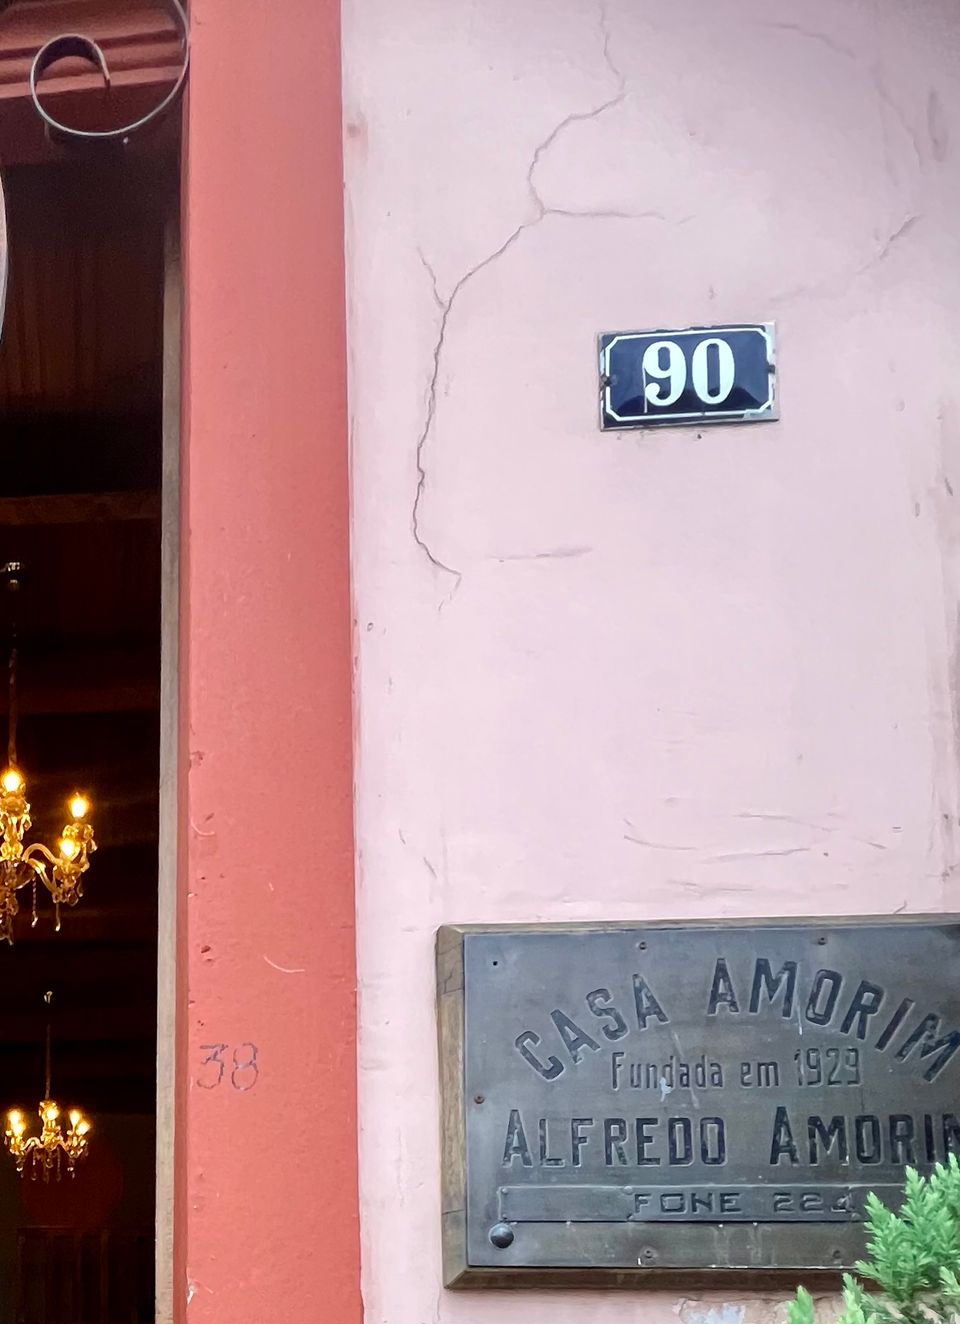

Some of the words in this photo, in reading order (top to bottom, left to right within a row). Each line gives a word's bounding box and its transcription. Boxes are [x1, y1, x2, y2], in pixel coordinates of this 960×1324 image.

[642, 338, 736, 409] 90
[514, 973, 670, 1082] CASA
[706, 957, 960, 1084] AMORIM
[196, 1042, 259, 1091] 38
[611, 1051, 725, 1090] Fundada
[740, 1058, 780, 1088] em
[793, 1047, 862, 1087] 1929
[501, 1108, 727, 1168] ALFREDO
[633, 1192, 742, 1214] FONE
